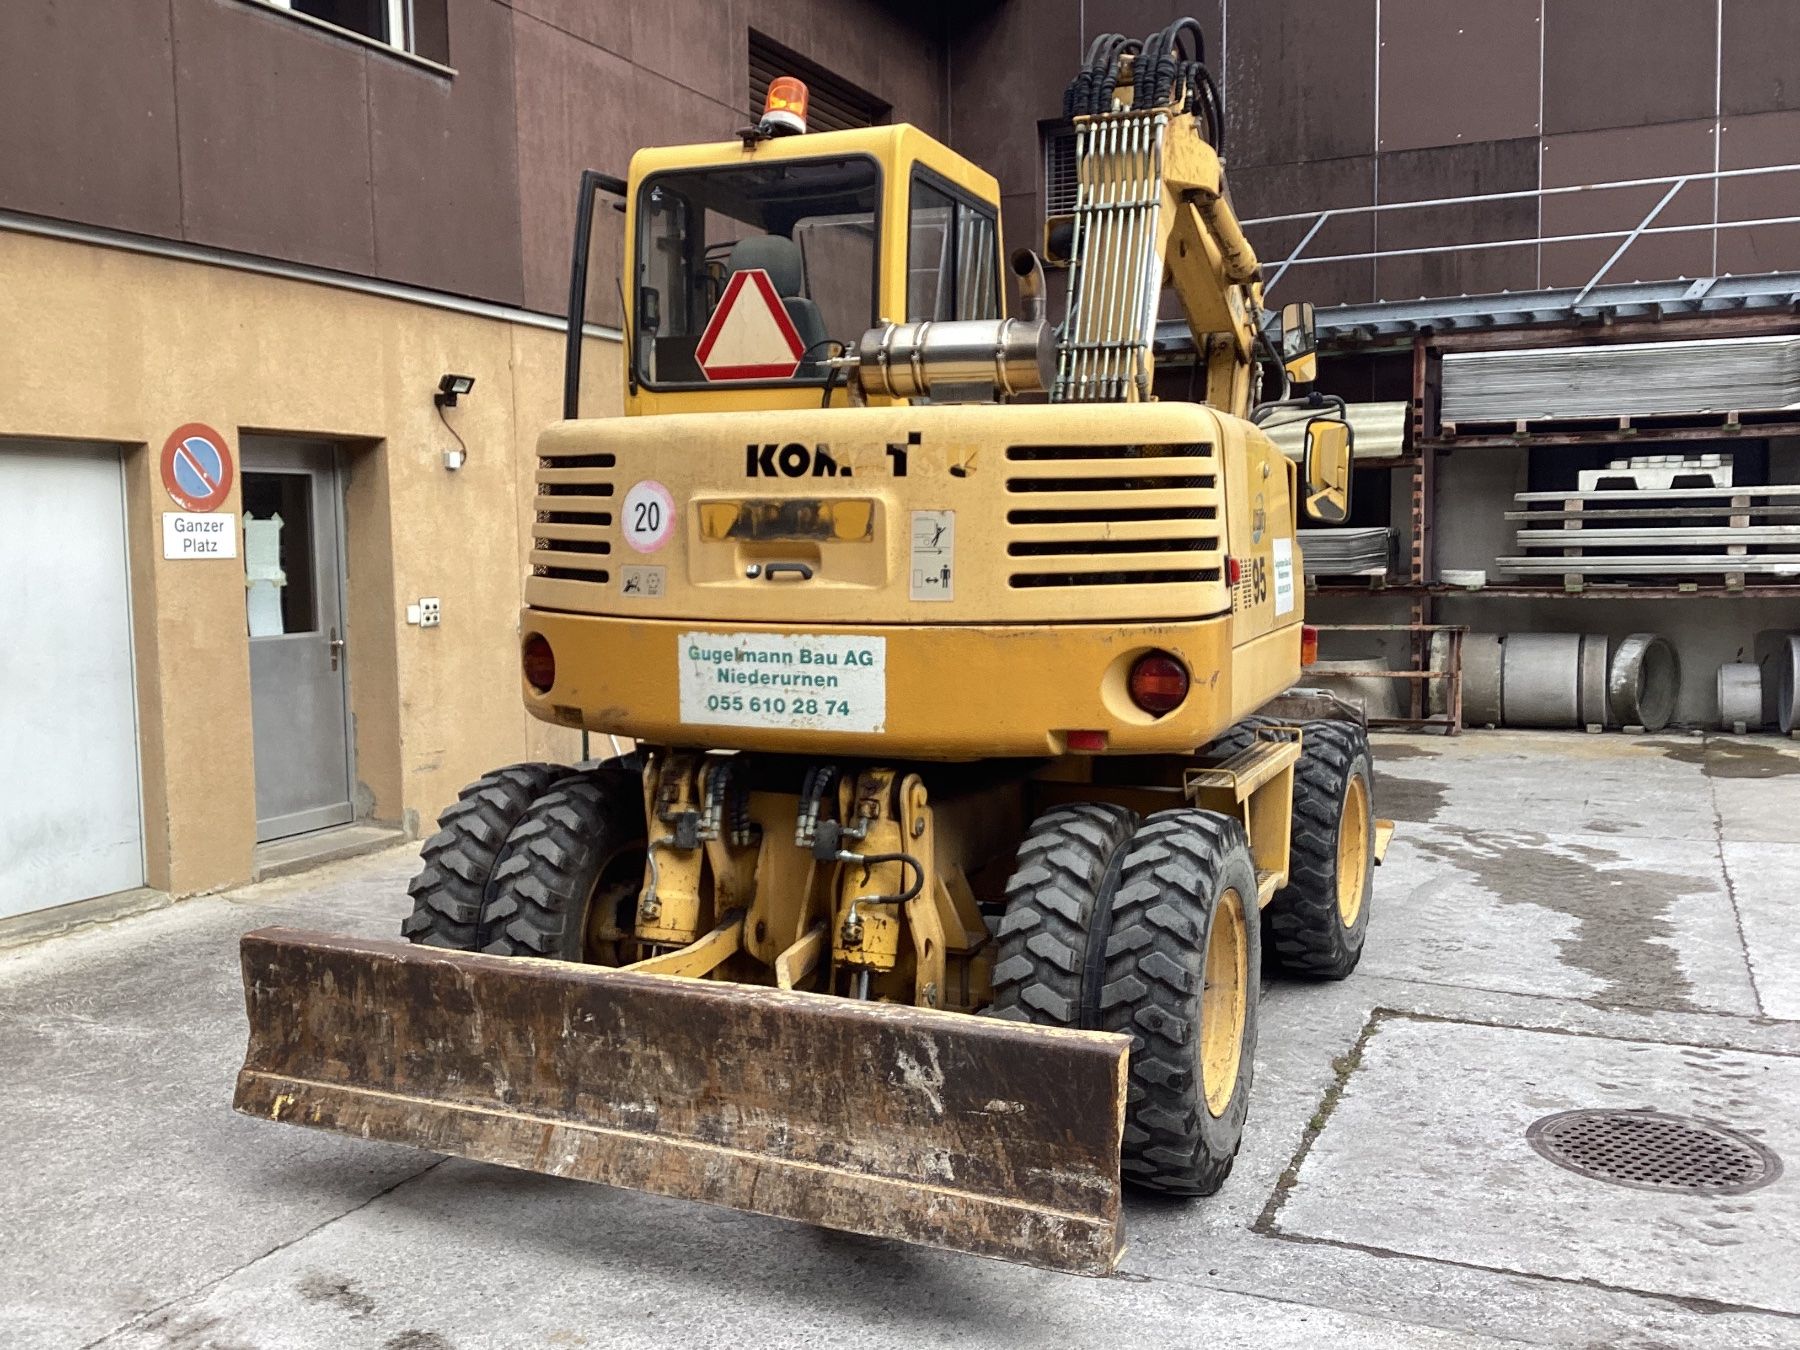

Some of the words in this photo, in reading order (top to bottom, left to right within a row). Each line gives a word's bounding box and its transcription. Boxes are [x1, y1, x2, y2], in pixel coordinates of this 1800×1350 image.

[174, 517, 225, 533] Ganzer
[634, 501, 660, 532] 20
[183, 538, 218, 553] Platz
[1252, 556, 1267, 605] 95
[688, 645, 793, 665] Gugelmann
[800, 648, 838, 665] Bau
[843, 650, 874, 666] AG
[716, 667, 838, 688] Niederurnen
[707, 694, 743, 711] 055
[749, 696, 786, 714] 610
[792, 698, 818, 715] 28
[824, 700, 850, 716] 74
